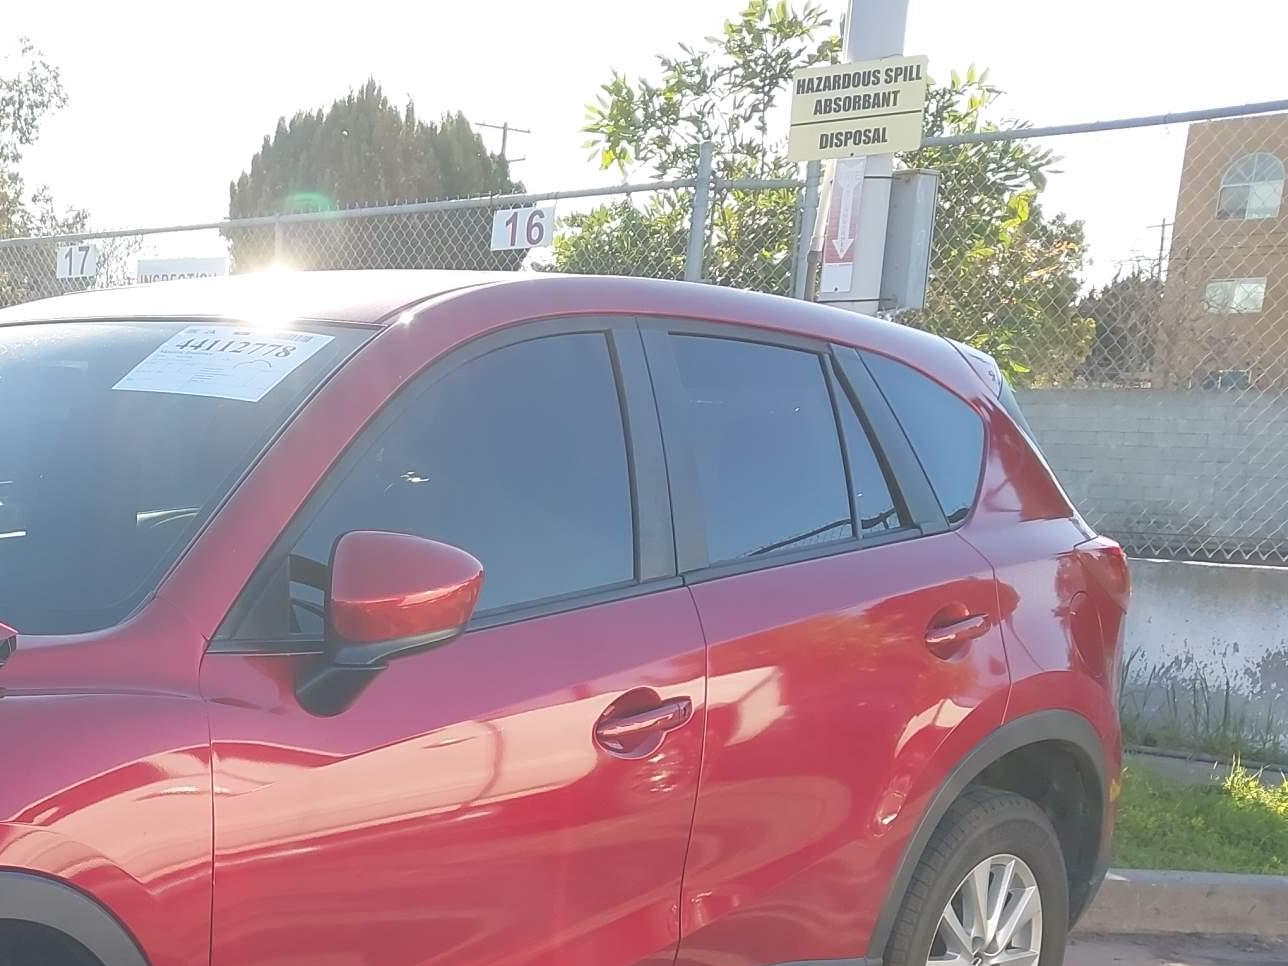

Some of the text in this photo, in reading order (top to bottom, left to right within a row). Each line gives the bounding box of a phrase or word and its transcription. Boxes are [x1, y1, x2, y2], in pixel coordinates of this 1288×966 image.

[796, 64, 922, 95] HAZARDOUS SPILL
[814, 90, 900, 115] ABSORBANT
[819, 127, 888, 149] DISPOSAL
[505, 210, 545, 246] 16
[65, 246, 90, 275] 17
[175, 338, 297, 358] 44112778
